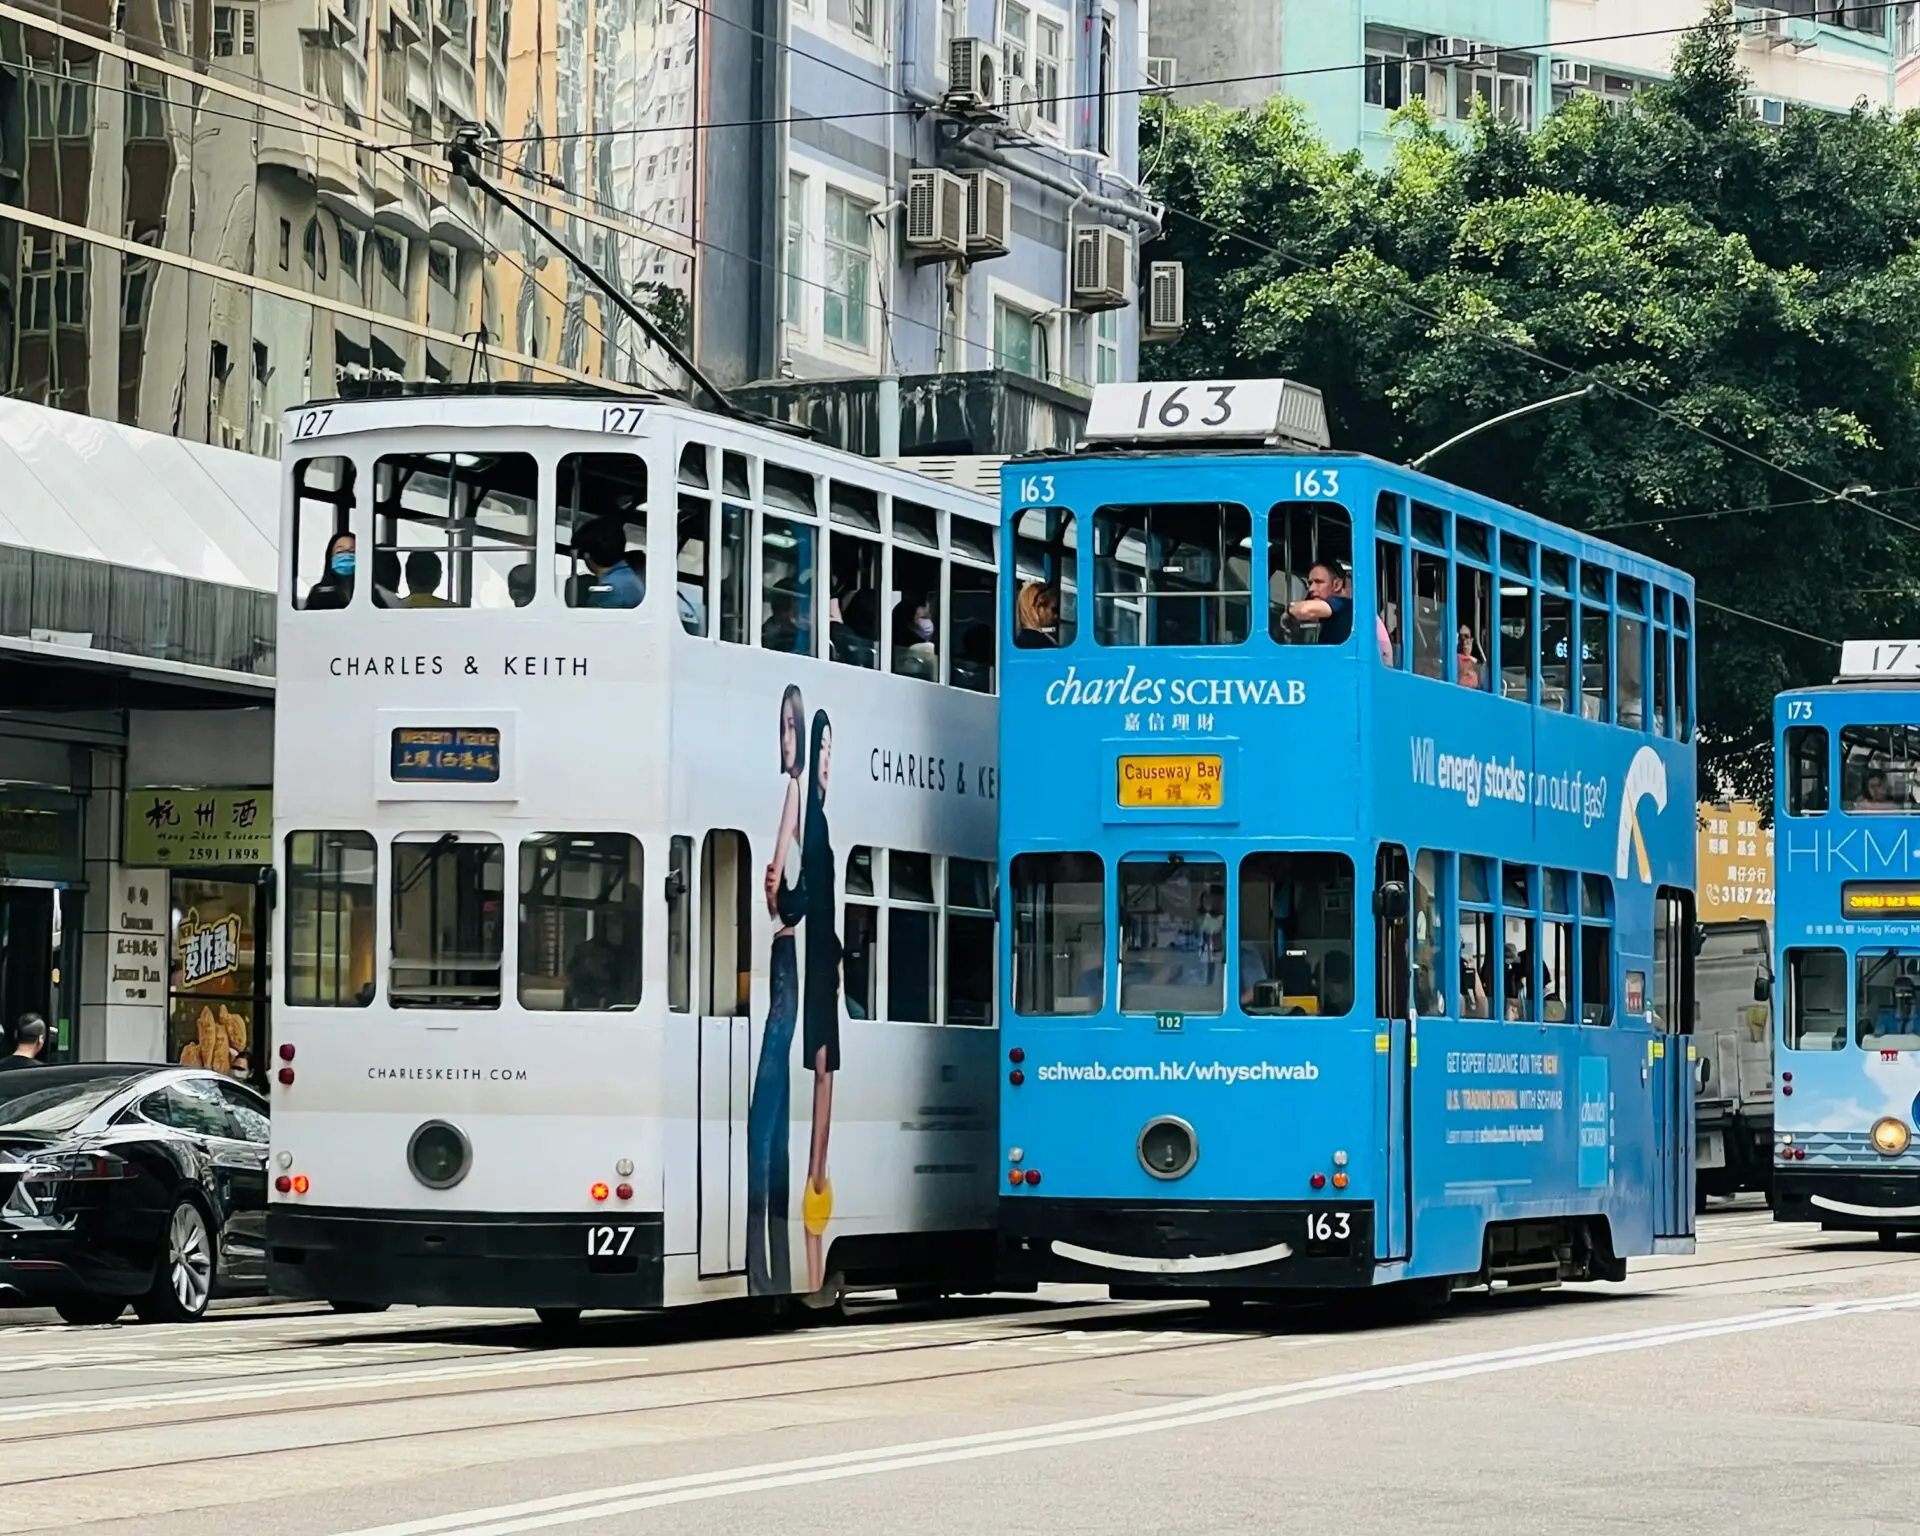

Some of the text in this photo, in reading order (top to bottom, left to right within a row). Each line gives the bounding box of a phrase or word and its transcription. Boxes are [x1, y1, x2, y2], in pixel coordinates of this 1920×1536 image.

[1137, 386, 1237, 428] 163
[296, 410, 333, 438] 127
[602, 408, 645, 434] 127
[1021, 476, 1055, 502] 163
[1295, 470, 1339, 497] 163
[330, 656, 589, 676] CHARLES & KEITH
[1046, 665, 1306, 706] charles SCHWAB
[1124, 712, 1215, 732] 嘉信理財
[1788, 701, 1813, 720] 173
[870, 747, 946, 792] CHARLES
[956, 761, 966, 795] &
[1124, 761, 1222, 782] Causeway Bay
[1410, 735, 1436, 786] Will
[1438, 753, 1484, 808] energy
[1484, 755, 1526, 804] stocks
[1550, 772, 1570, 812] out
[1571, 770, 1583, 815] of
[1583, 775, 1608, 829] gas?
[145, 797, 257, 829] 杭州酒
[189, 847, 259, 860] 2591 1898
[1722, 886, 1753, 905] 3187
[1857, 923, 1882, 937] Hong
[1884, 923, 1909, 937] Kong
[1159, 1016, 1181, 1029] 102
[368, 1067, 528, 1081] CHARLESKEITH.COM
[1038, 1061, 1319, 1085] schwab.com.hk/whyschwab
[1447, 1052, 1460, 1073] GET
[1461, 1052, 1486, 1073] EXPERT
[1486, 1053, 1518, 1074] GUIDANCE
[1519, 1054, 1530, 1074] ON
[1530, 1054, 1543, 1075] THE
[1307, 1212, 1350, 1241] 163
[588, 1226, 637, 1256] 127
